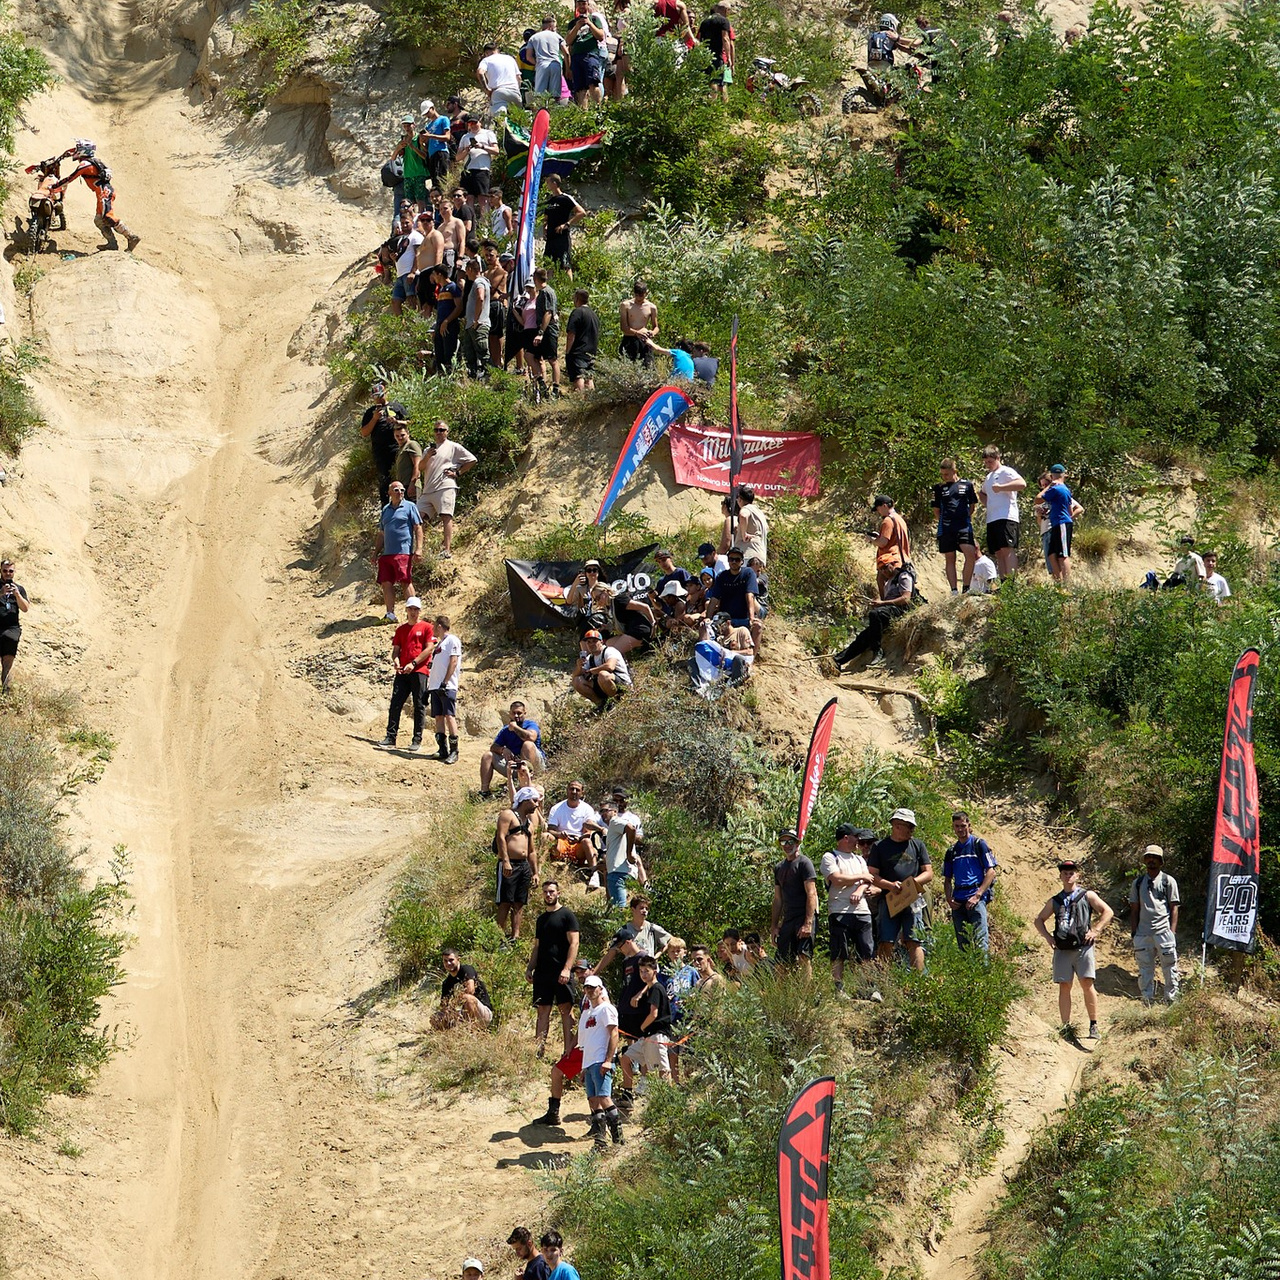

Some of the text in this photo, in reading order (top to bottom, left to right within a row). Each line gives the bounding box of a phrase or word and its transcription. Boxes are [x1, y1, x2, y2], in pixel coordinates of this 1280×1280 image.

[697, 436, 784, 462] Milaukee
[1222, 885, 1255, 915] 20
[1219, 914, 1250, 926] YEARS
